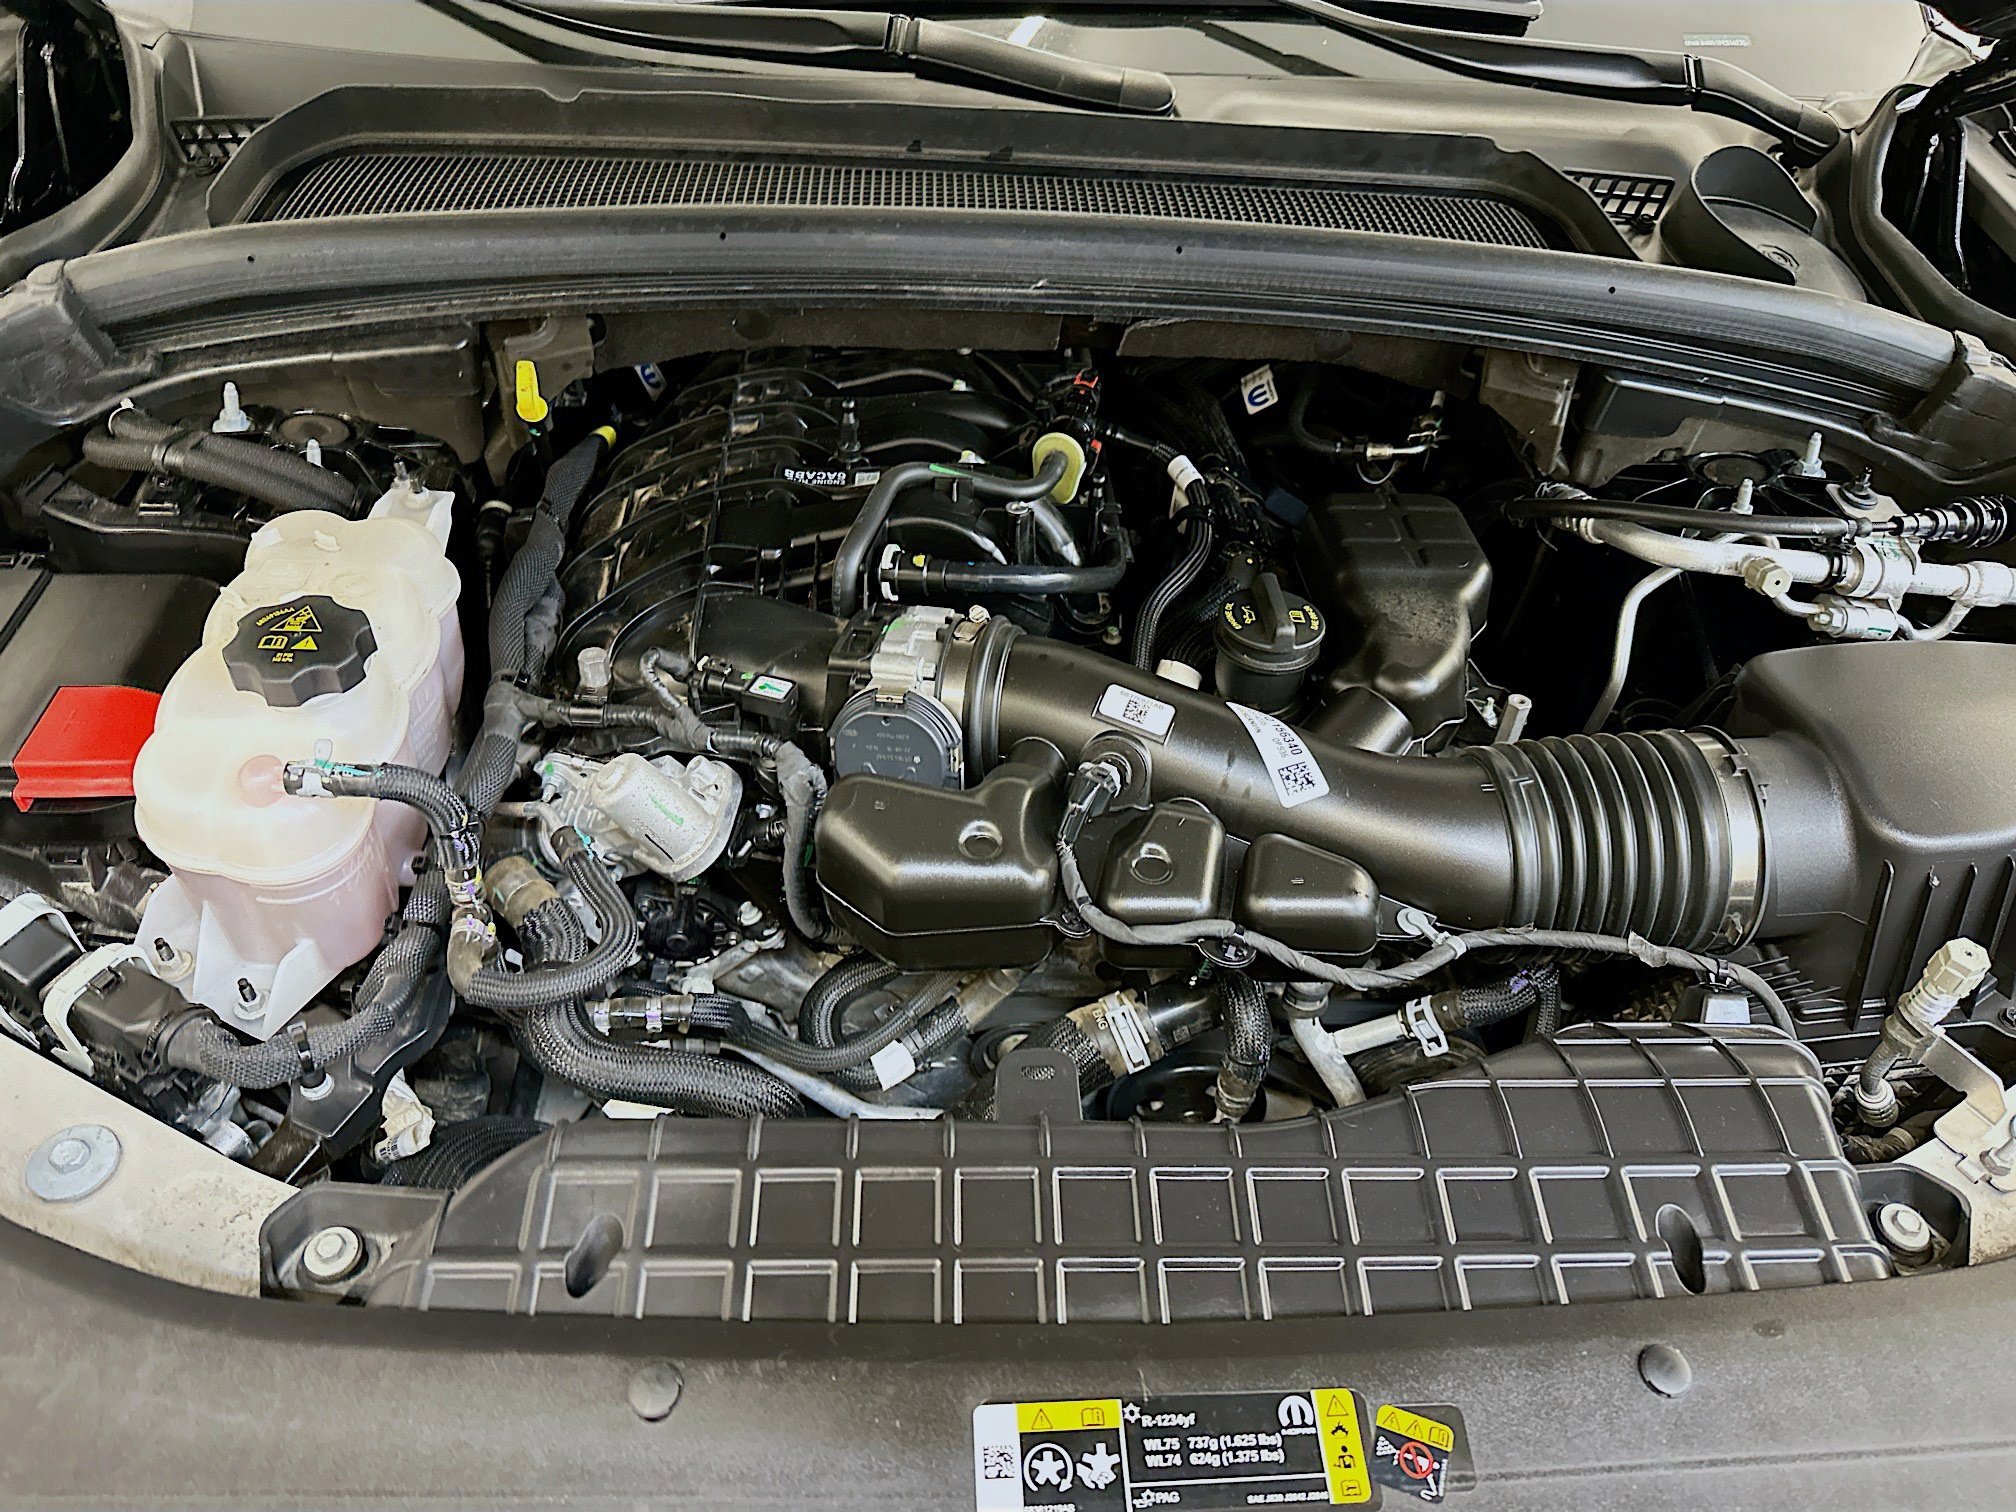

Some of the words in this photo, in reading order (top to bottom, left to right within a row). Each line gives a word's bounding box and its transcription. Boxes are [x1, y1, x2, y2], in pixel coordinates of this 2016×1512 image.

[1092, 1009, 1108, 1030] ENG
[1141, 1413, 1196, 1429] R-1234yf
[1143, 1438, 1181, 1451] WL75
[1187, 1436, 1219, 1451] 737g
[1219, 1434, 1257, 1450] (1.625
[1258, 1433, 1282, 1448] lbs)
[1145, 1454, 1182, 1467] WL74
[1189, 1453, 1220, 1467] 624g
[1222, 1450, 1259, 1466] (1.375
[1260, 1449, 1284, 1464] lbs)
[1155, 1491, 1180, 1504] PAG
